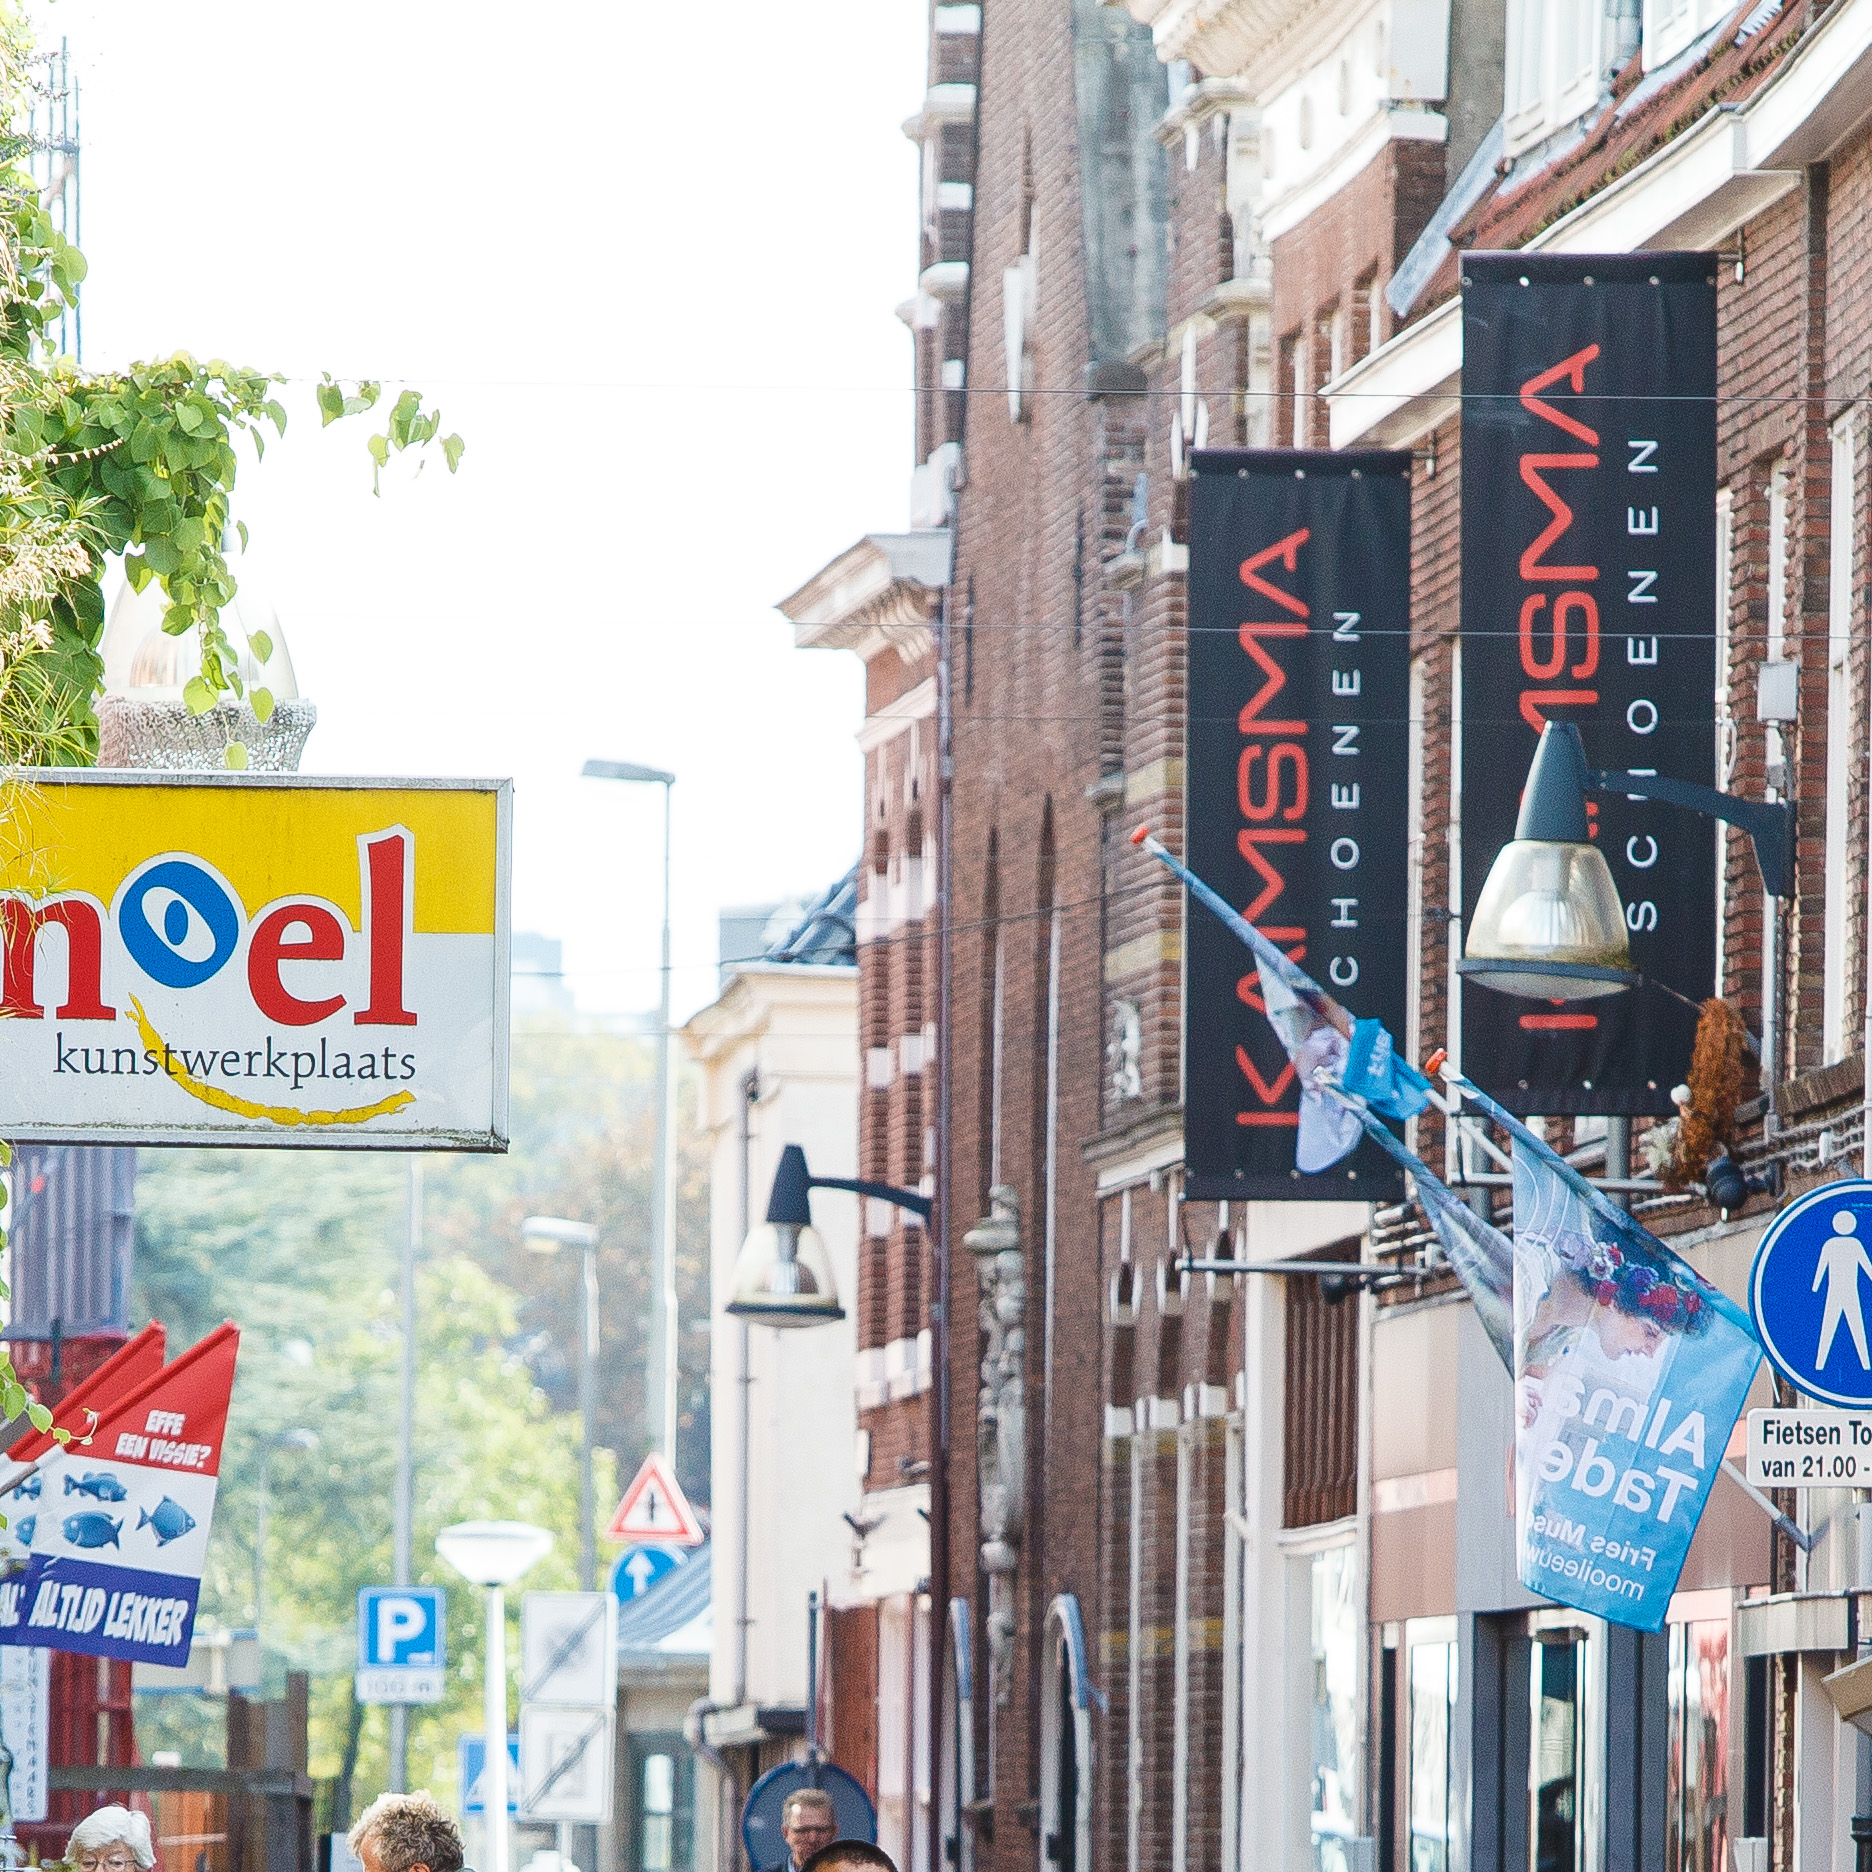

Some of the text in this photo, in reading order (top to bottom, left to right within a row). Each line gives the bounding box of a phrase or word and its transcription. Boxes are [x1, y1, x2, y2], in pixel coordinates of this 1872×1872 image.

[1329, 610, 1361, 987] CHOENEN
[53, 1031, 417, 1090] kunstwerkplaats
[144, 1409, 187, 1437] EFFE
[1762, 1419, 1841, 1446] Fietsen
[114, 1432, 212, 1469] EEN VISSIE?
[1761, 1459, 1795, 1478] van
[1802, 1455, 1857, 1478] 21.00
[27, 1579, 189, 1646] ALTIJD LEKKER
[376, 1597, 428, 1663] P
